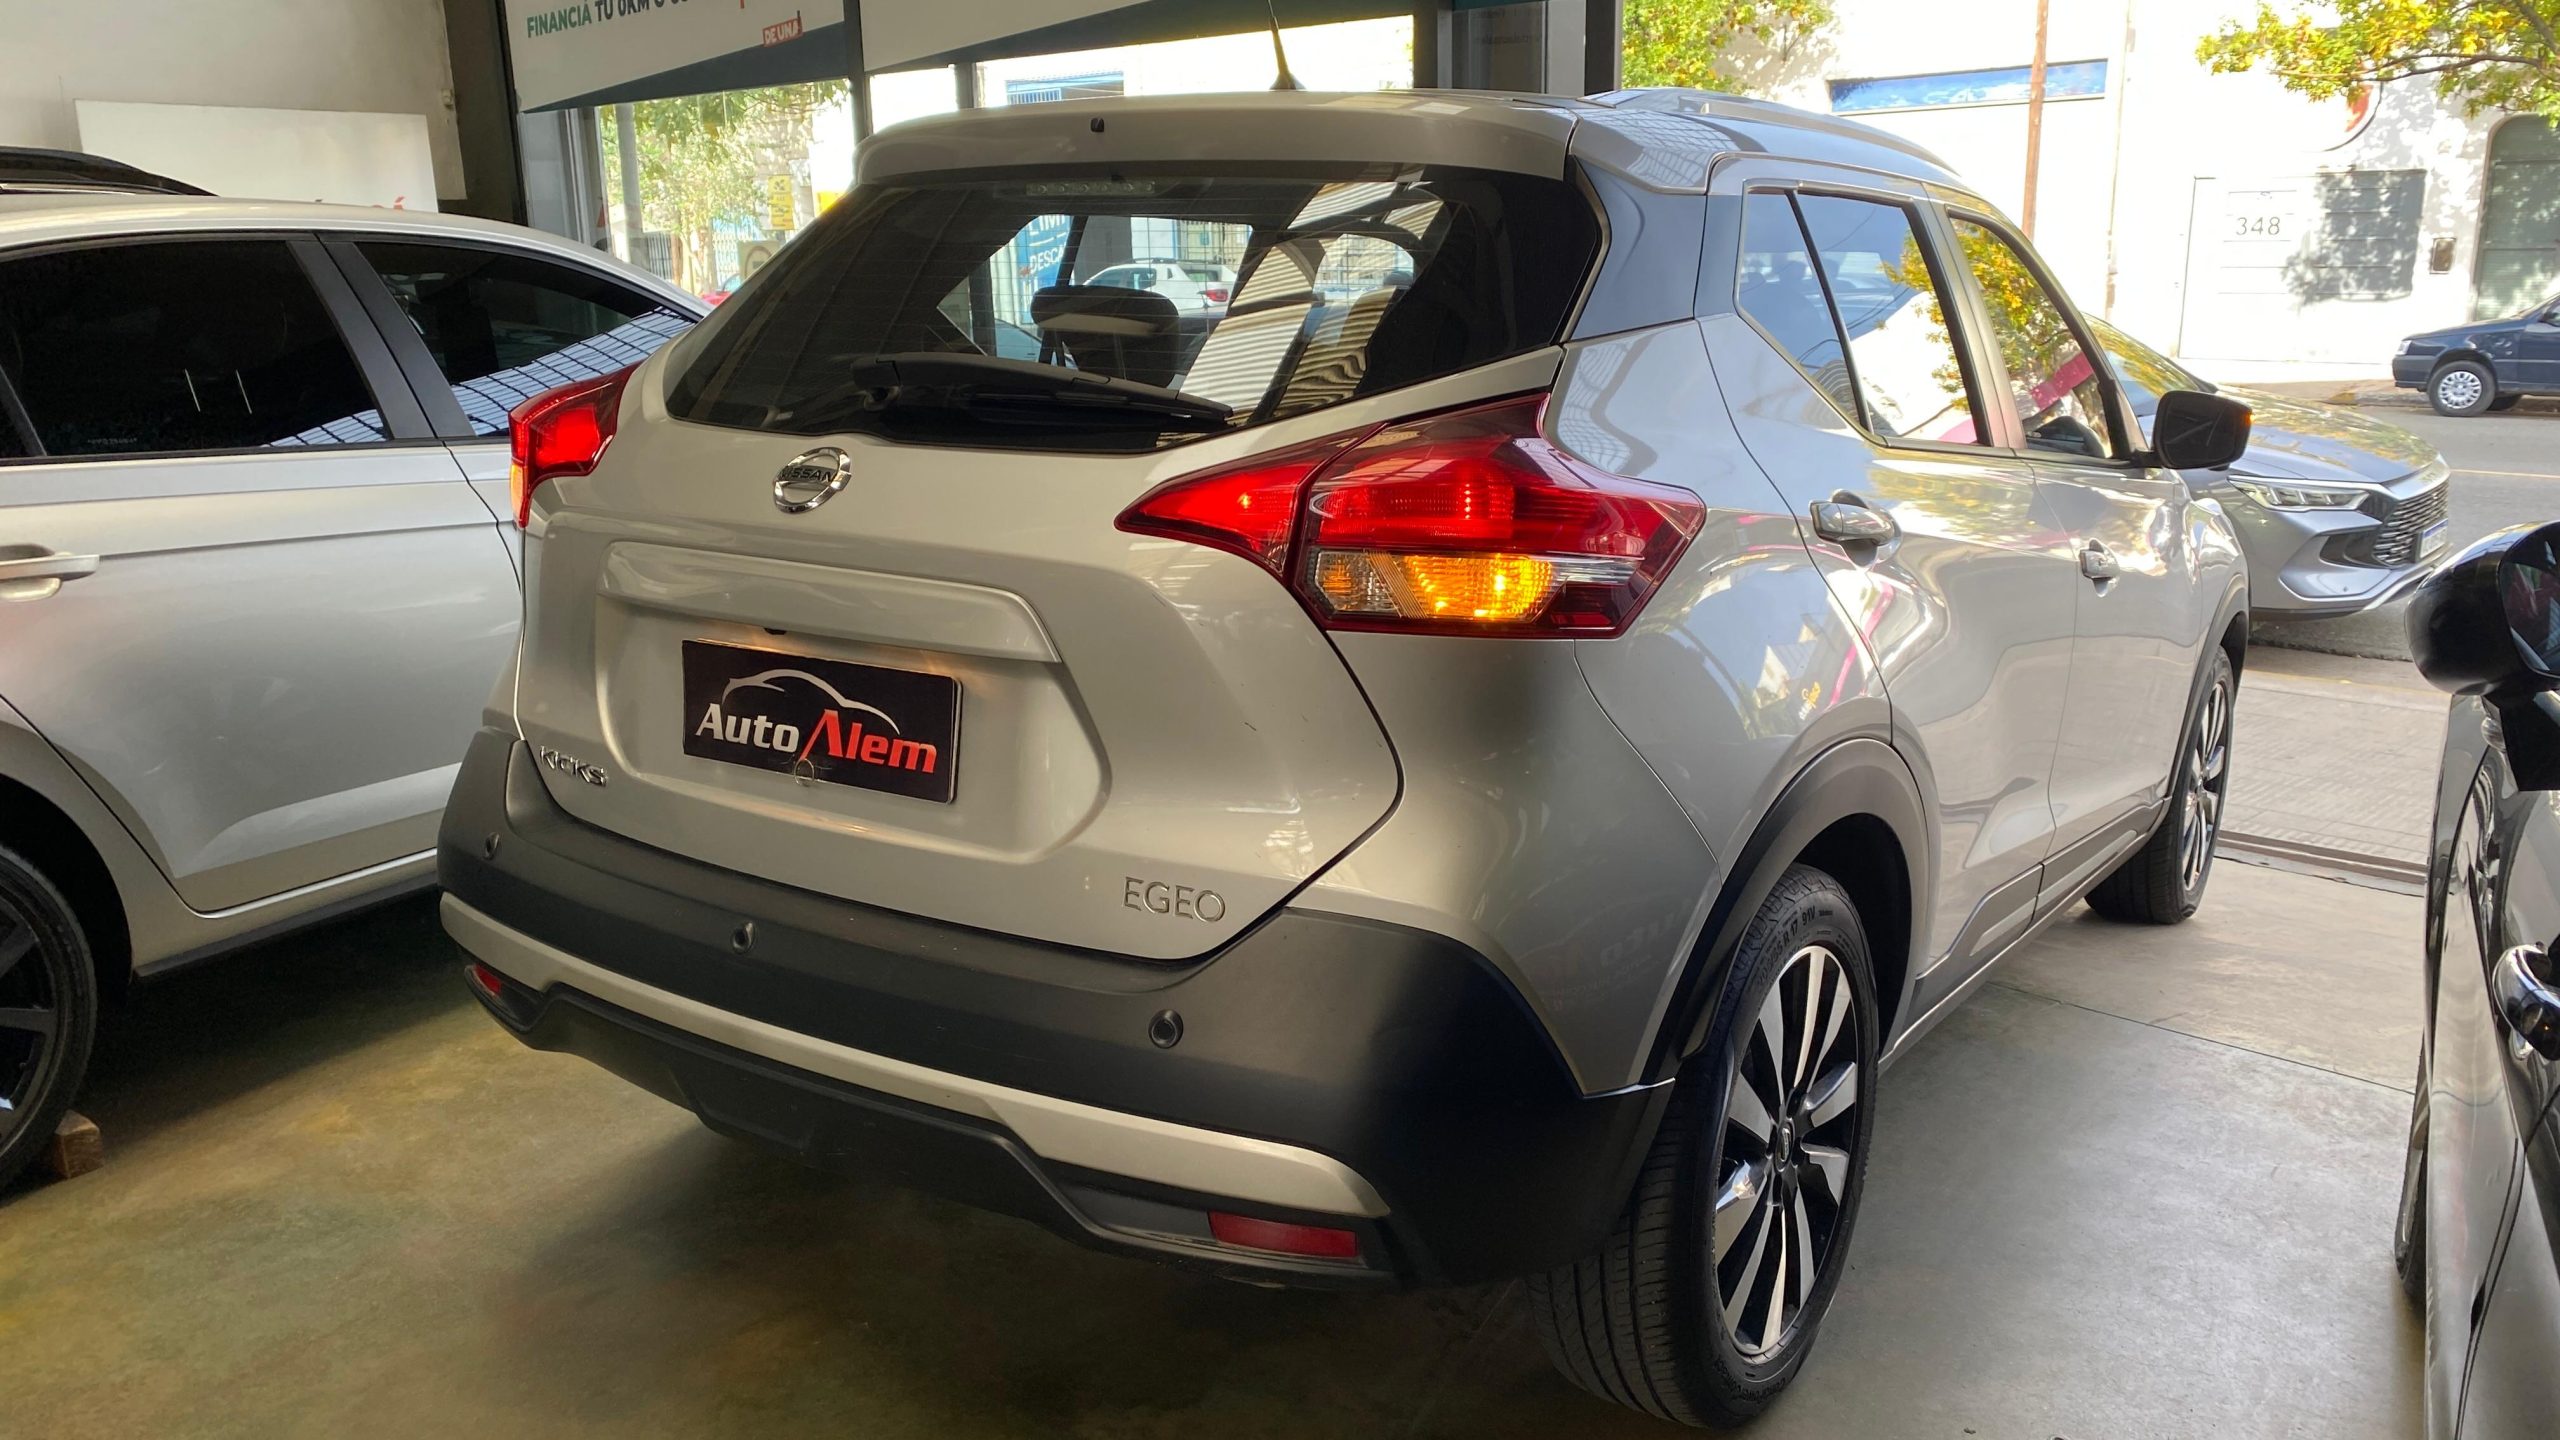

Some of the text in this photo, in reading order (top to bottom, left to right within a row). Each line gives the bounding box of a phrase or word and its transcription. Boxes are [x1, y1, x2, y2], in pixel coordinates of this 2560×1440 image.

[595, 0, 613, 22] TU
[2235, 216, 2281, 236] 348
[696, 702, 938, 774] Auto Alem
[1123, 876, 1226, 922] EGEO
